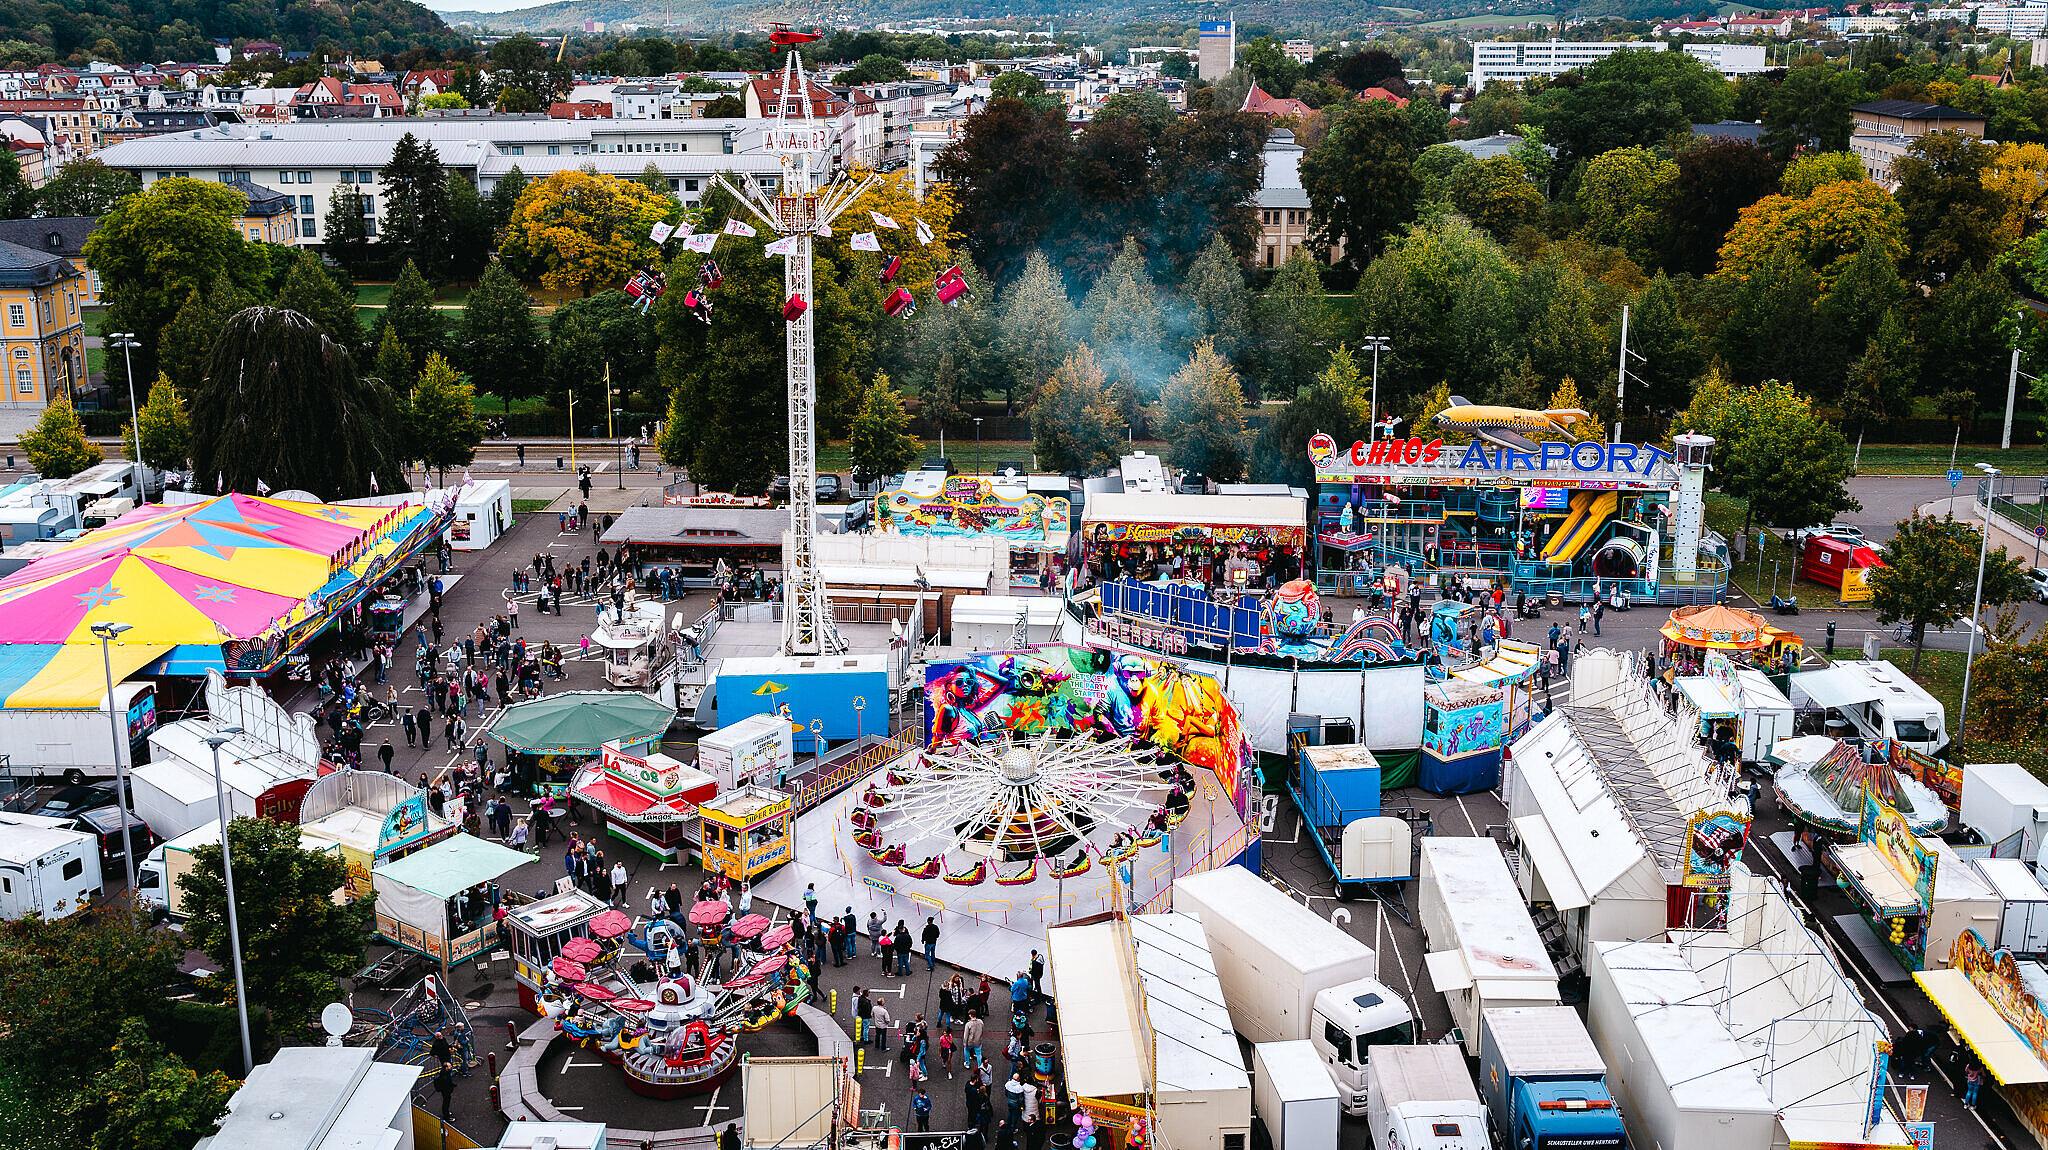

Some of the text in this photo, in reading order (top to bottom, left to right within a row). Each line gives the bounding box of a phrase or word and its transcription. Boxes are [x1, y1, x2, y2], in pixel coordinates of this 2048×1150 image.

[1351, 437, 1673, 476] CHAOS AIRPORT
[1088, 617, 1188, 655] SUPERSTAR
[1070, 680, 1108, 690] THE PARTY
[1071, 672, 1106, 682] LET'S GET
[1074, 689, 1106, 698] STARTED
[745, 801, 787, 824] SUPER STAR
[746, 844, 787, 869] Kasse
[1913, 1130, 1929, 1139] 12
